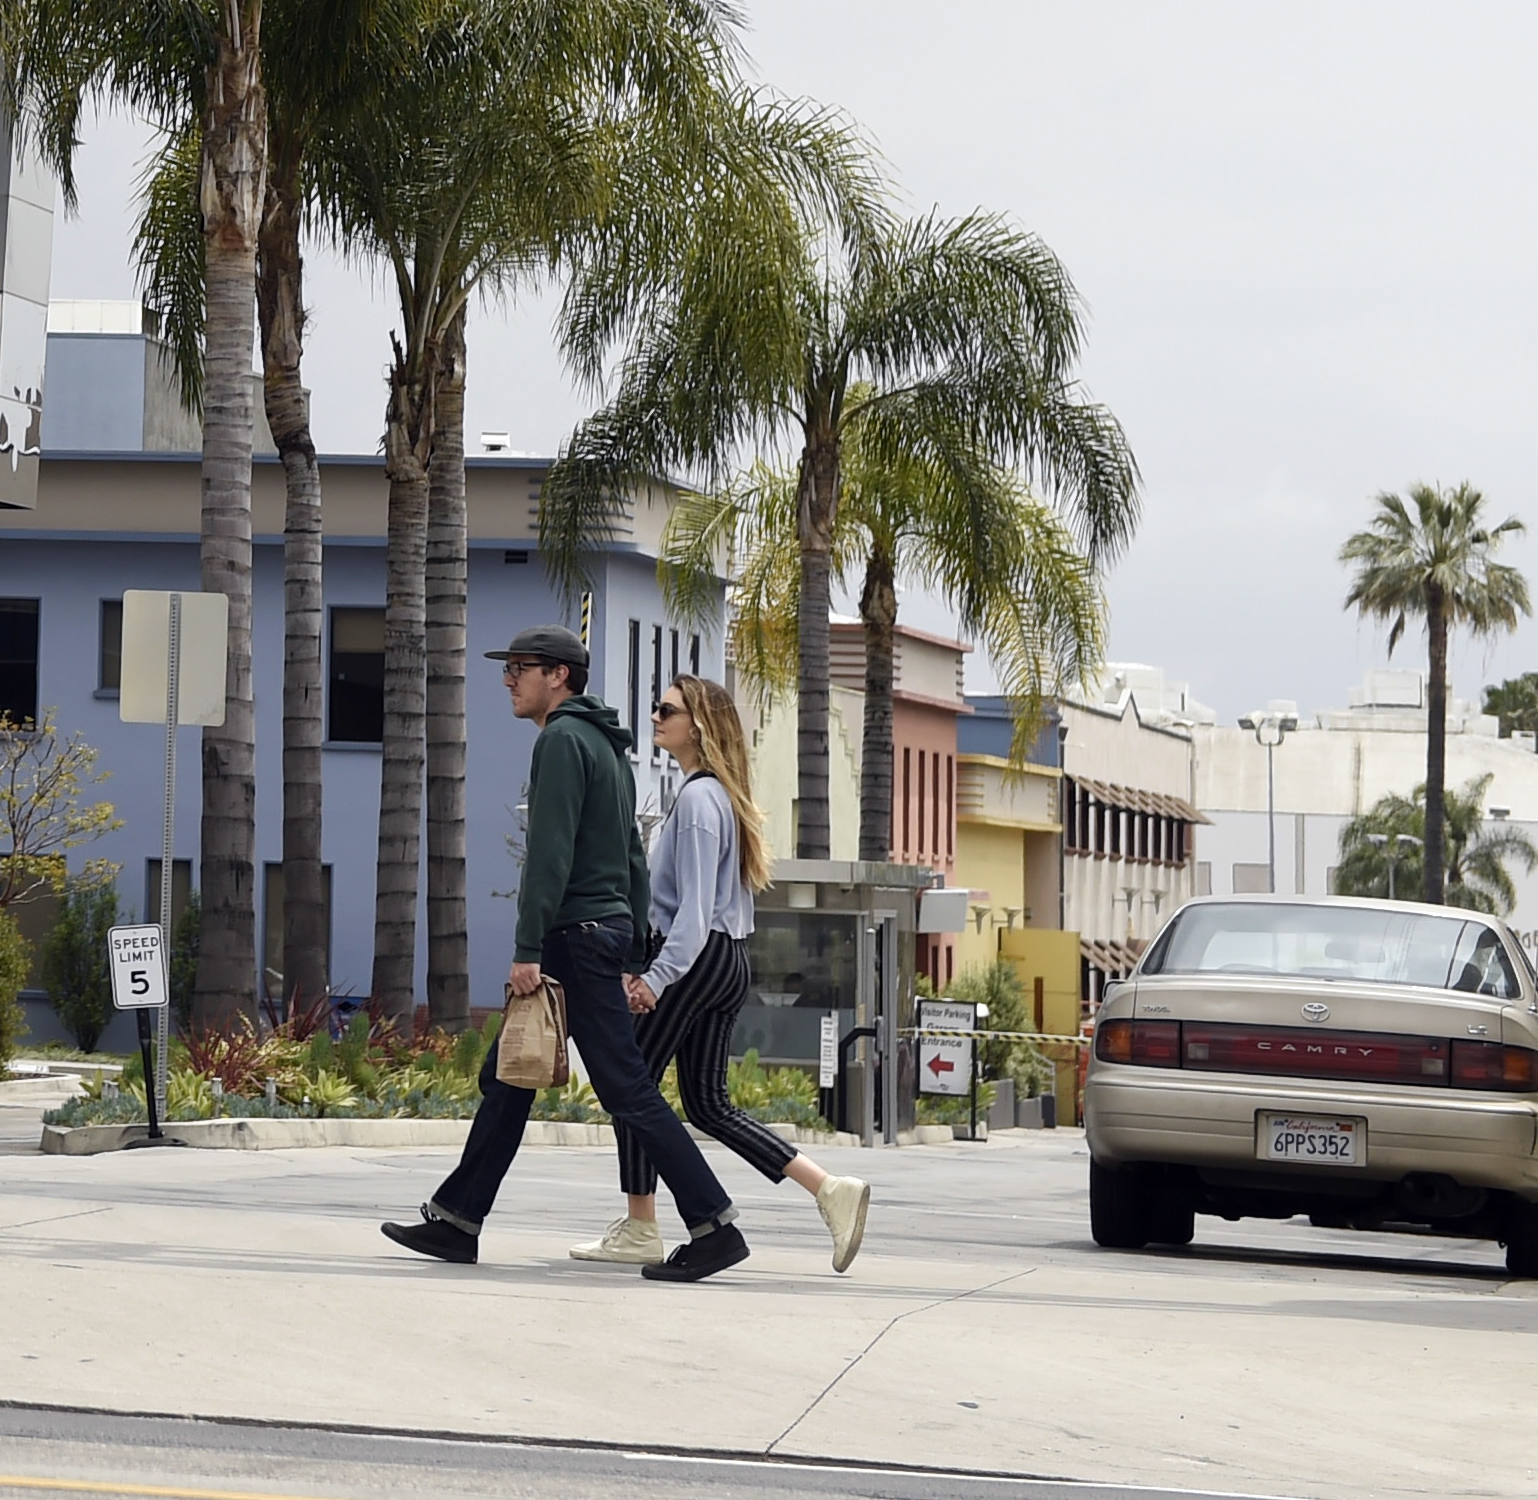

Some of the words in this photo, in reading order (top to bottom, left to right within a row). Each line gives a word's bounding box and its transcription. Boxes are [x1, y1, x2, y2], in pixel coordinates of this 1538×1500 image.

[114, 937, 159, 949] SPEED
[119, 951, 154, 962] LIMIT
[130, 970, 150, 995] 5
[944, 1008, 971, 1023] Parking
[921, 1037, 963, 1048] Entrance
[1257, 1042, 1373, 1056] CAMRY
[1273, 1132, 1350, 1157] 6PPS352
